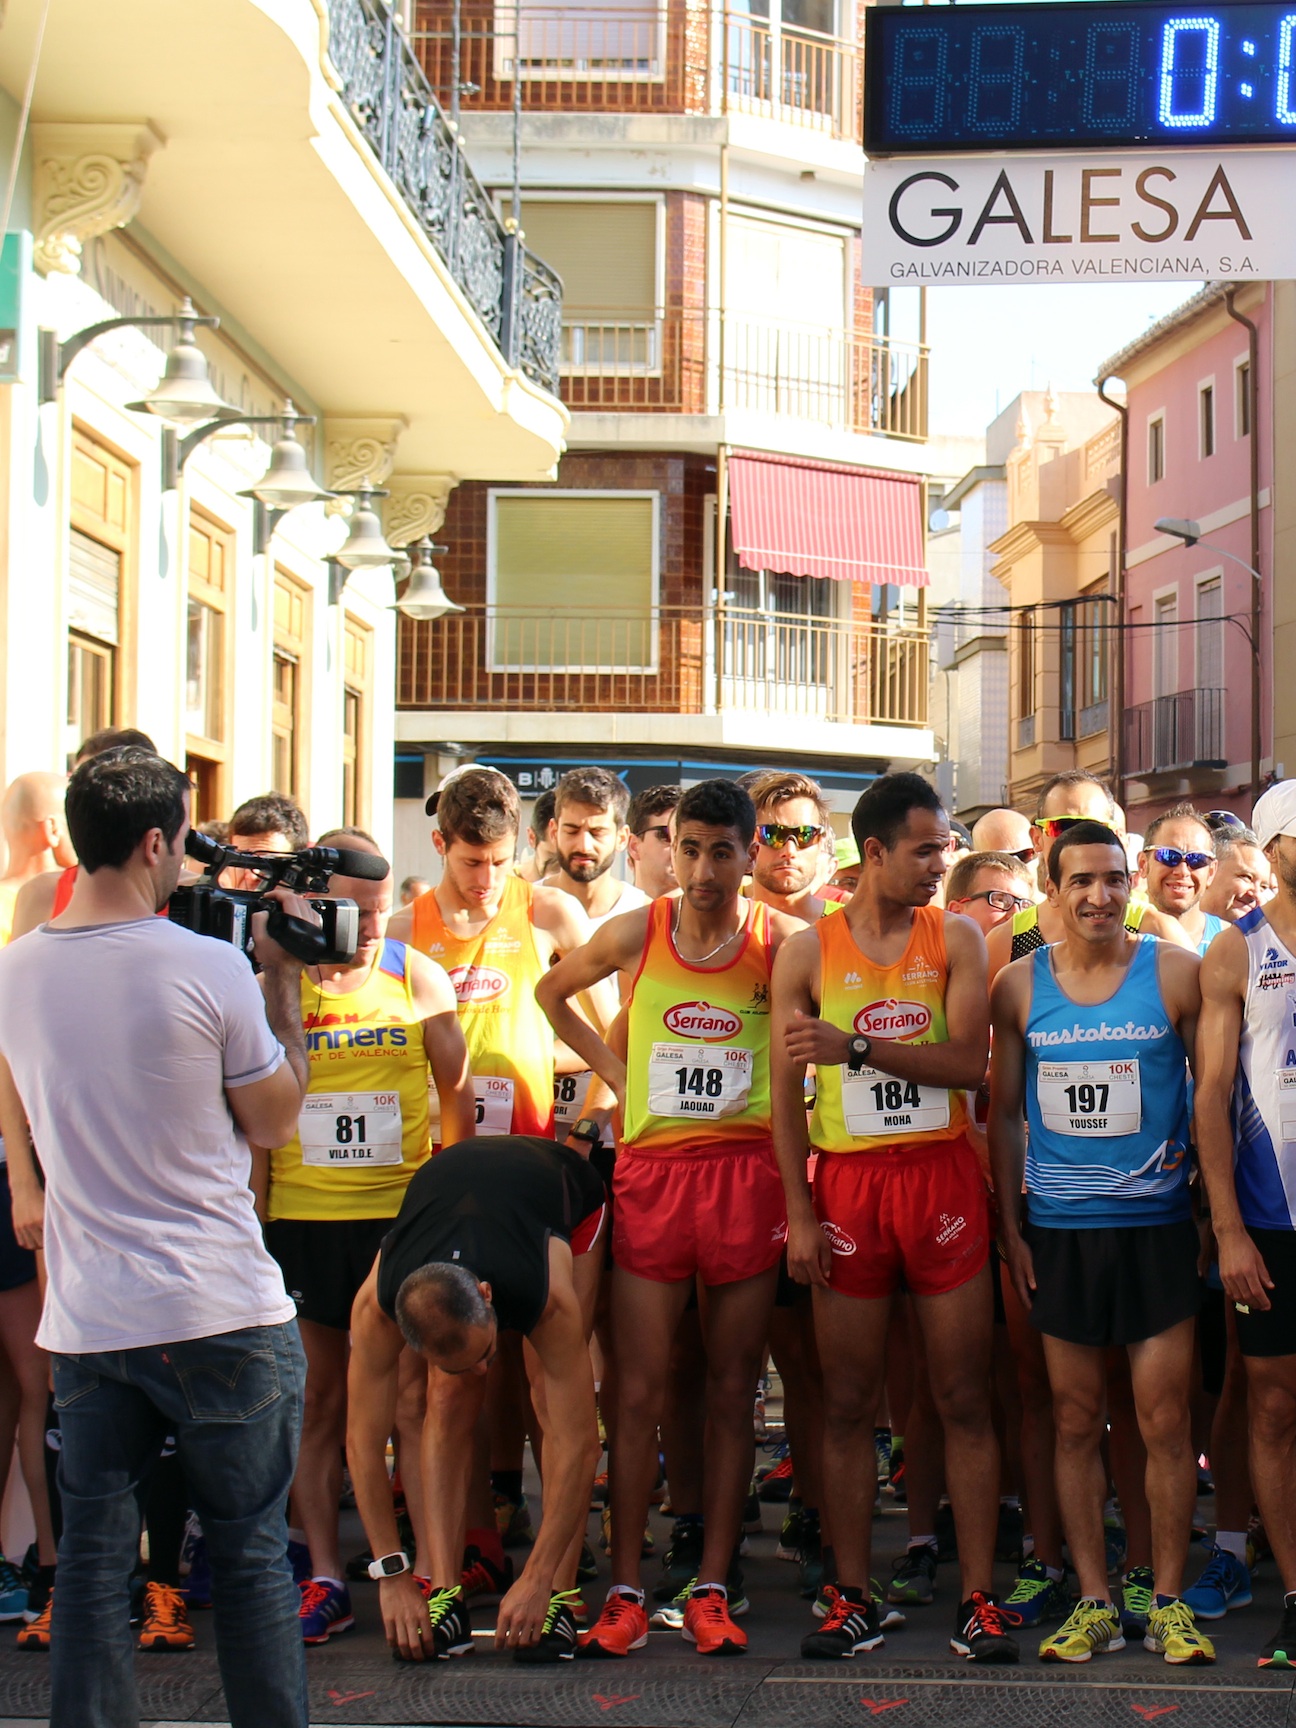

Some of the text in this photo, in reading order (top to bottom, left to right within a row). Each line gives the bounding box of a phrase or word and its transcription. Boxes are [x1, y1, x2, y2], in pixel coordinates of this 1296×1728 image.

[888, 164, 1253, 248] GALESA
[889, 256, 1260, 279] GALVANIZADORA VALENCIANA, S.A.
[902, 970, 939, 982] SERRANO
[453, 978, 502, 994] errano
[670, 1011, 736, 1033] Serrano
[862, 1012, 927, 1032] Serrano
[1027, 1021, 1168, 1048] maskokotas
[329, 1051, 346, 1060] DE
[724, 1051, 748, 1063] 10K
[847, 1069, 877, 1078] GALESA
[1042, 1063, 1134, 1078] GALESA 10K
[486, 1081, 509, 1091] 10K
[675, 1067, 723, 1098] 148
[373, 1095, 396, 1106] 10K
[870, 1080, 921, 1111] 184
[1064, 1083, 1110, 1114] 197
[680, 1100, 715, 1112] JAOUAD
[884, 1115, 912, 1127] MOHA
[1069, 1118, 1108, 1129] YOUSSEF
[336, 1115, 366, 1144] 81
[328, 1148, 374, 1159] VILA T.D.E.
[935, 1216, 965, 1243] SERRANO
